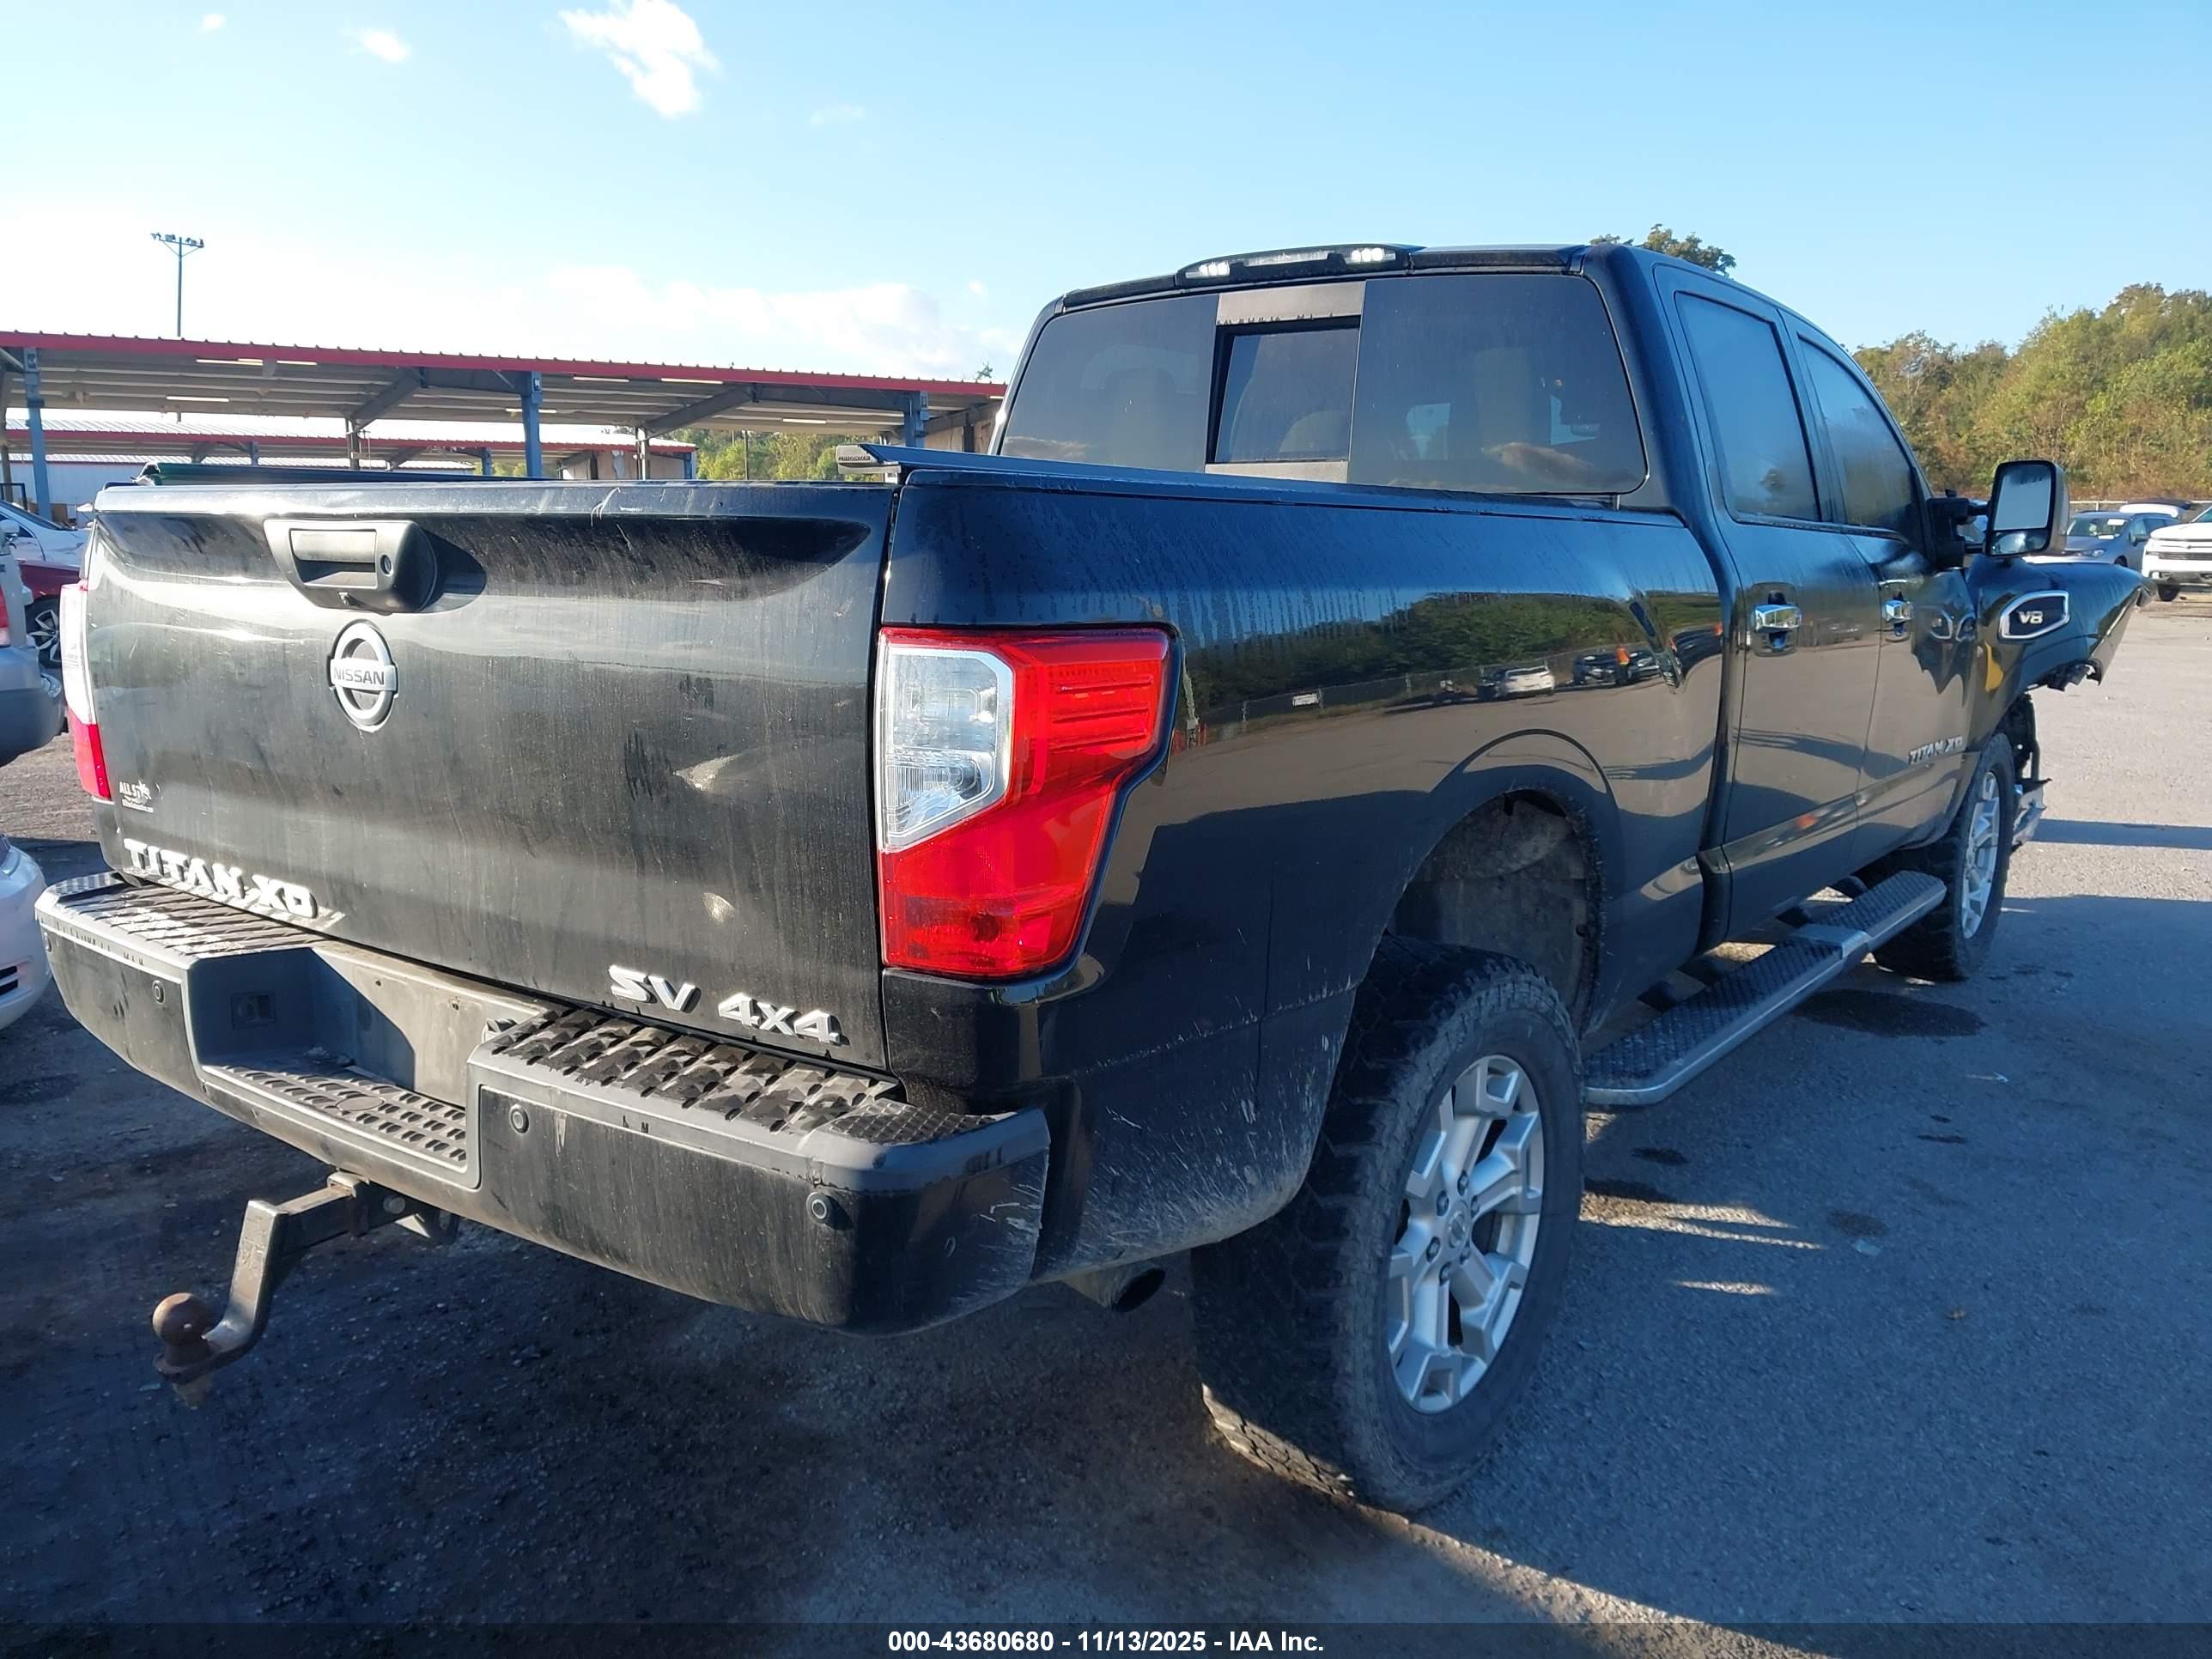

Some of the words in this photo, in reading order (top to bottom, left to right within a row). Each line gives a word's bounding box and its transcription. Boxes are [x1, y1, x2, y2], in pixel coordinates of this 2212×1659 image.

[2018, 611, 2043, 624] V8
[333, 666, 385, 685] NISSAN
[123, 838, 247, 899] TITAN
[252, 874, 319, 919] XD
[608, 964, 700, 1012] SV
